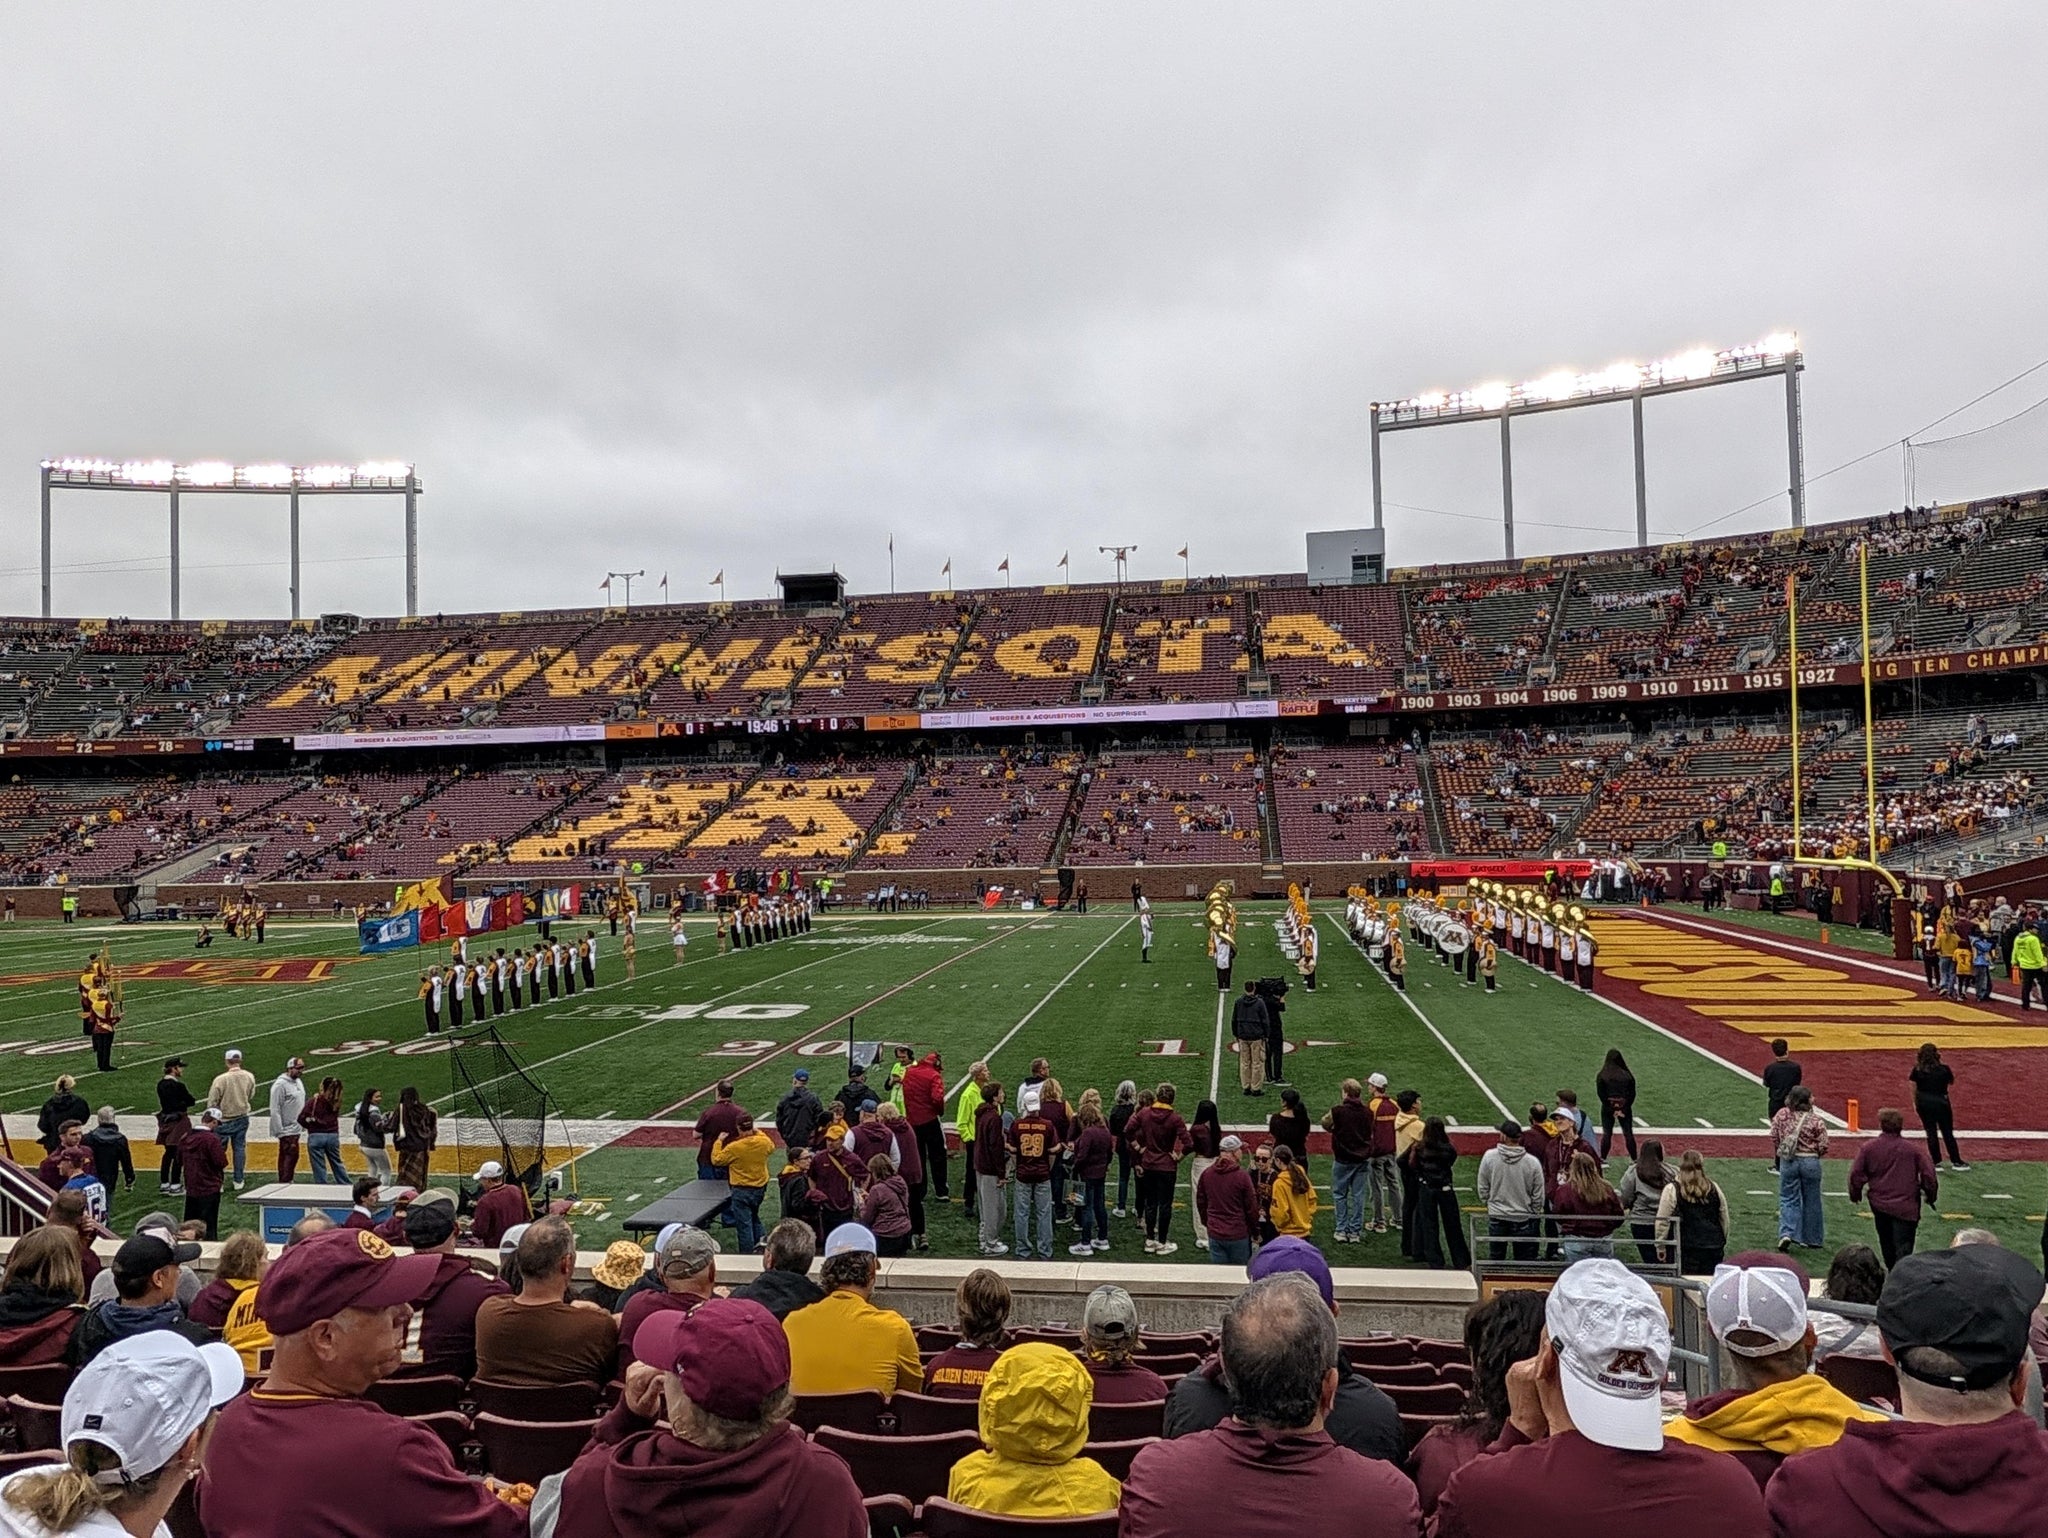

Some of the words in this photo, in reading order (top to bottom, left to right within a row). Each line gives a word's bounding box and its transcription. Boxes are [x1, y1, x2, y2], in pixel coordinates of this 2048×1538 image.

[268, 613, 1373, 708] MINNESOTA
[1912, 657, 1950, 674] TEN
[1966, 648, 2048, 668] CHAMPI
[1401, 696, 1434, 710] 1900
[1447, 694, 1481, 707] 1903
[1494, 691, 1529, 705] 1904
[1542, 688, 1577, 702] 1906
[1592, 685, 1627, 699] 1909
[1641, 682, 1678, 696] 1910
[1693, 677, 1729, 692] 1911
[1744, 673, 1783, 689] 1915
[1797, 668, 1836, 685] 1927
[1033, 712, 1086, 721] ACQUISITIONS
[1281, 704, 1316, 714] RAFFLE
[686, 722, 694, 736] 0
[747, 719, 779, 734] 19:46
[829, 717, 838, 731] 0
[158, 740, 174, 752] 78
[392, 735, 438, 743] ACQUISITIONS
[76, 742, 93, 754] 72
[1444, 930, 1465, 946] M
[1020, 1133, 1044, 1157] 29
[1607, 1349, 1652, 1379] M
[932, 1367, 962, 1384] GOLDEN
[1598, 1372, 1627, 1389] GOLDEN
